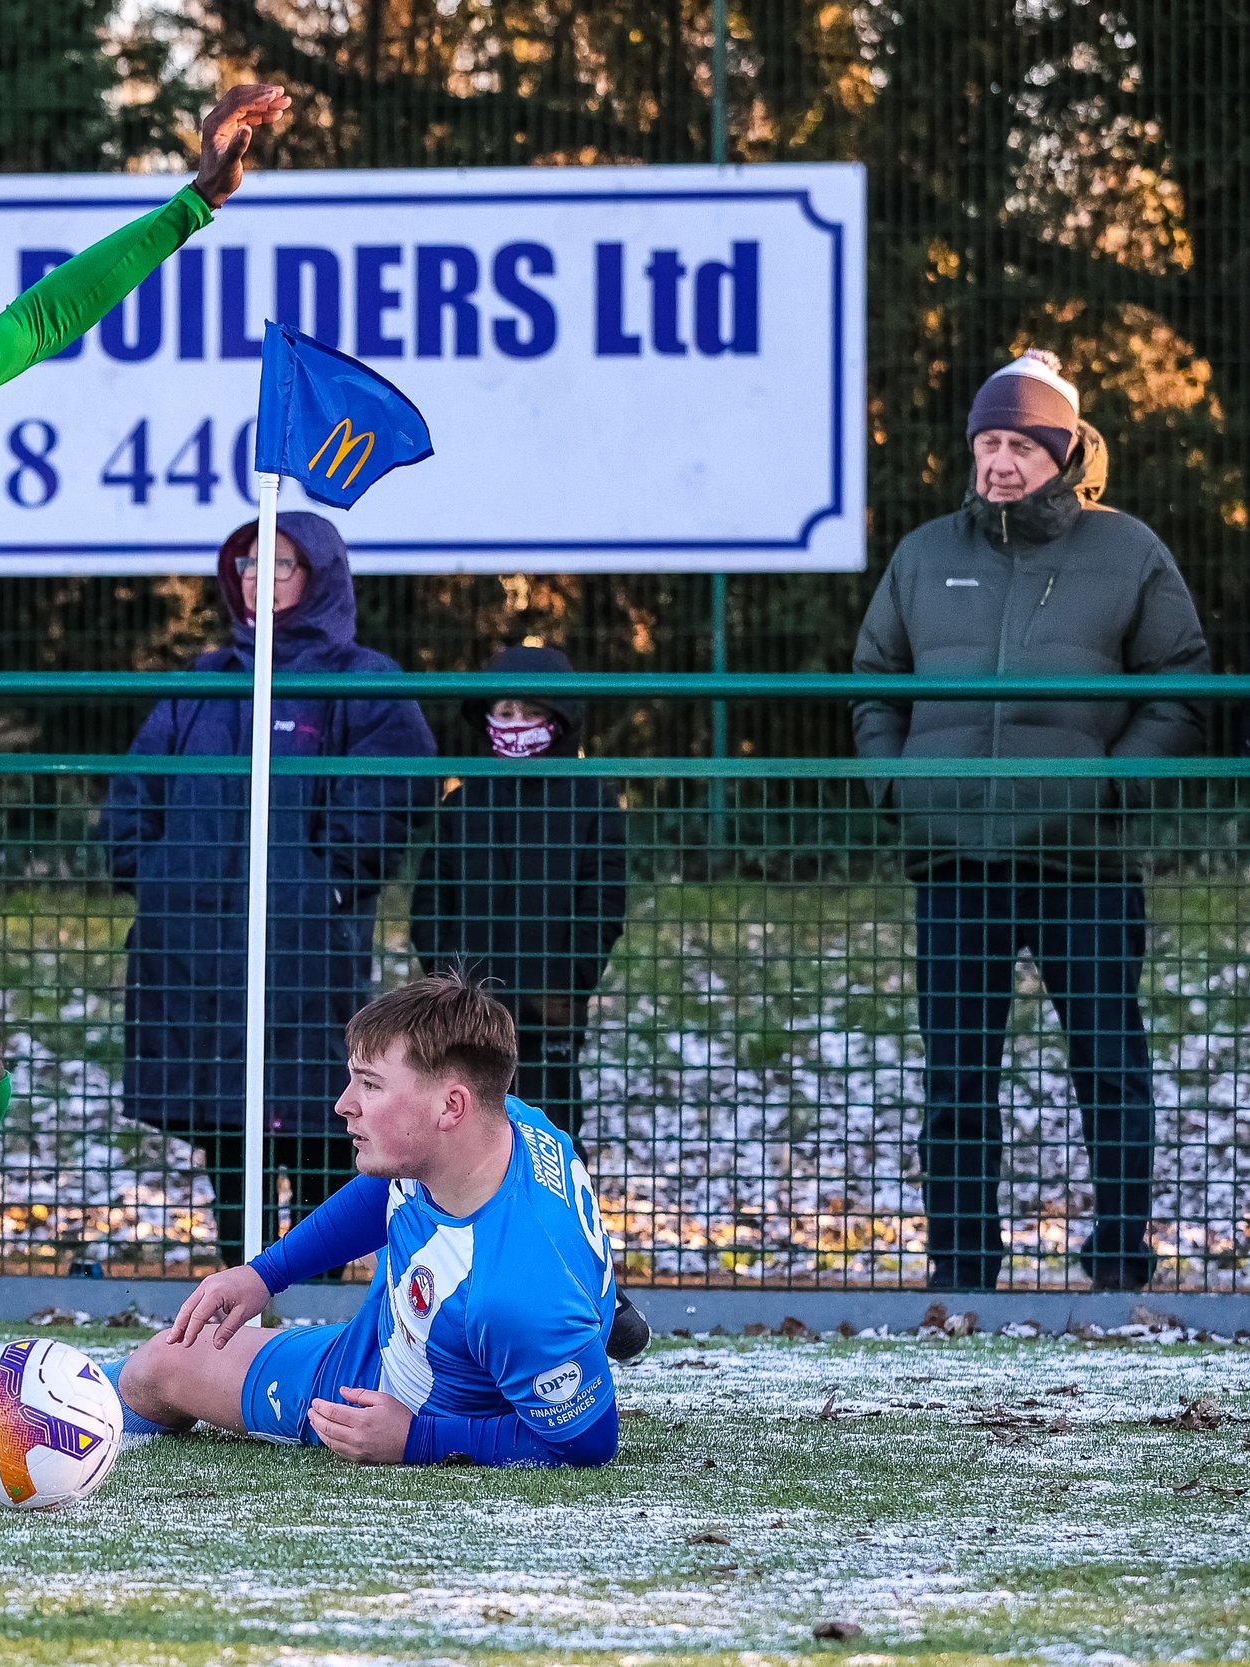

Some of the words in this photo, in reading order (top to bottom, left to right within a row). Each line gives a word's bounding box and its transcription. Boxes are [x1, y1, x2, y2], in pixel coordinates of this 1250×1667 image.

[594, 238, 758, 356] Ltd
[517, 1120, 548, 1187] SPORTING
[536, 1127, 566, 1200] TOUCH
[530, 1401, 575, 1418] FINANCIAL
[576, 1376, 603, 1403] ADVICE
[538, 1369, 578, 1396] DP's
[547, 1418, 555, 1427] &
[556, 1395, 596, 1425] SERVICES
